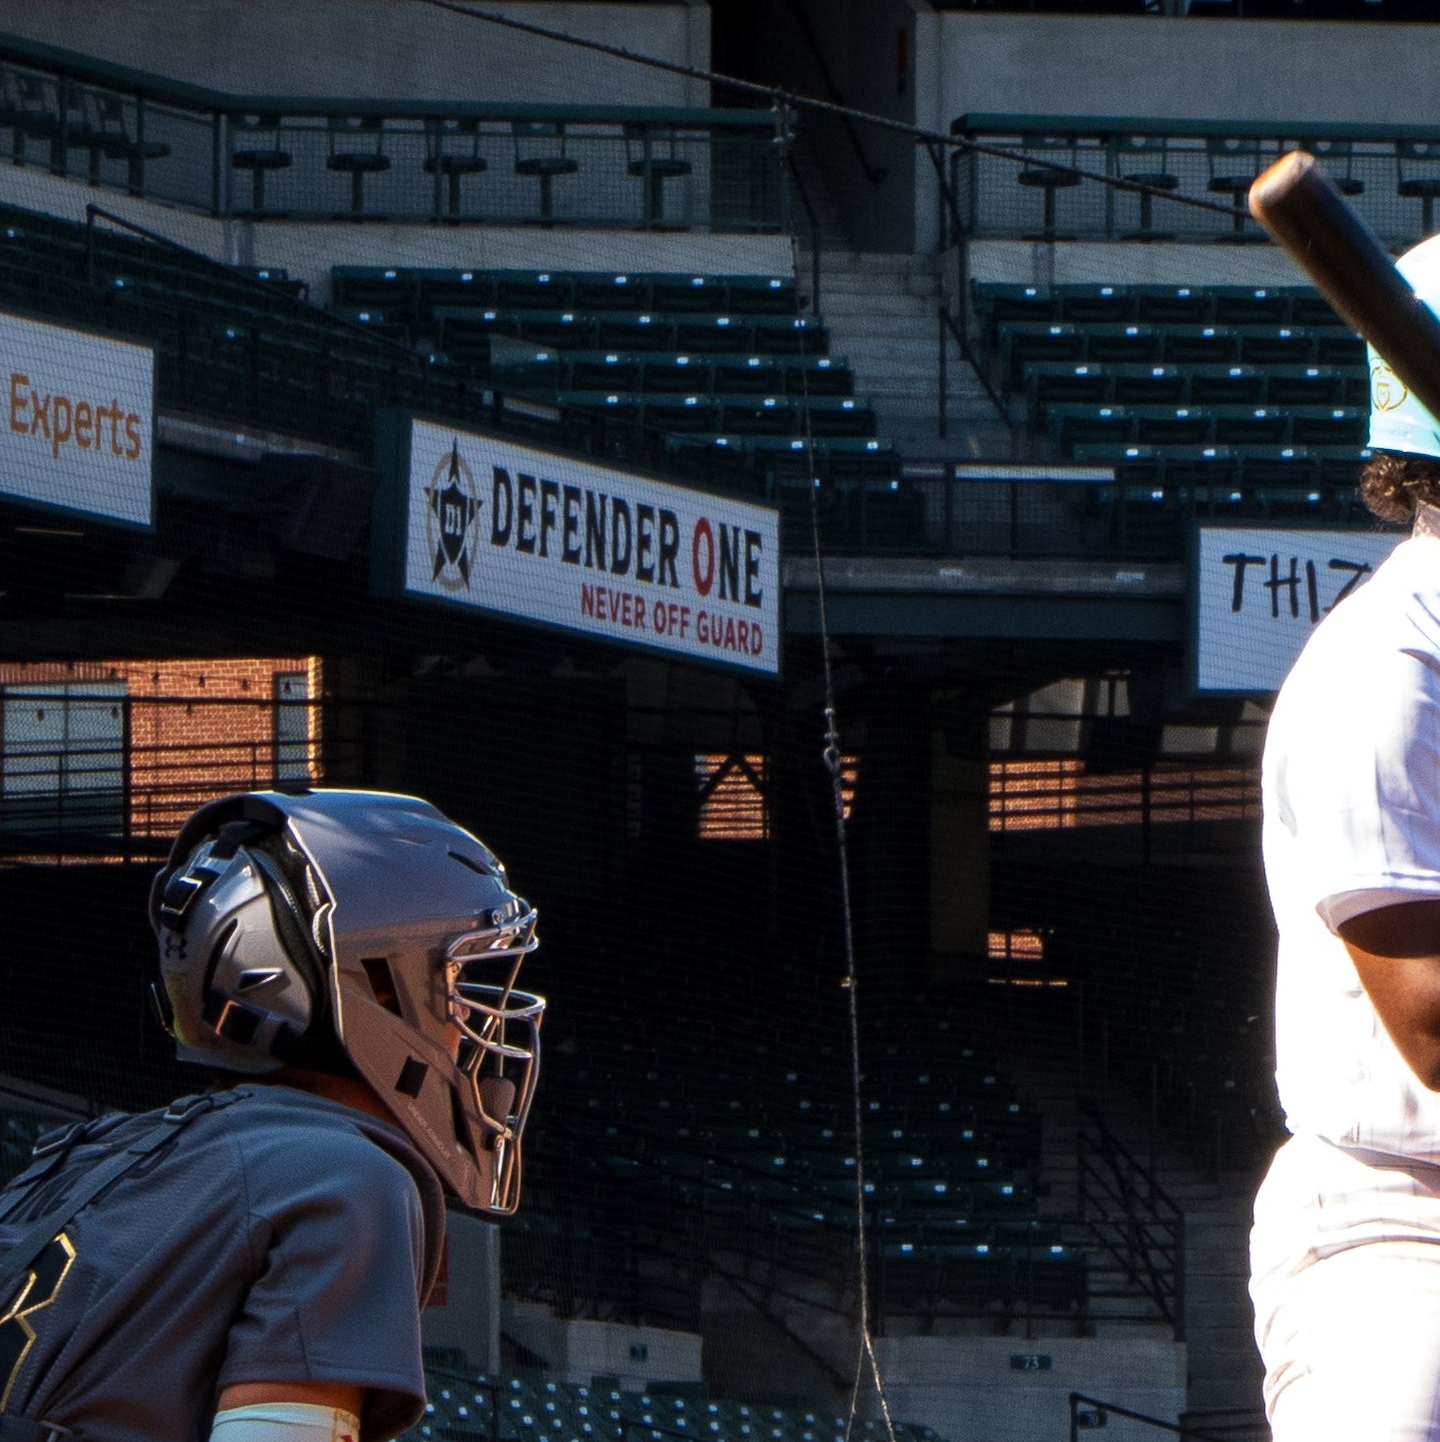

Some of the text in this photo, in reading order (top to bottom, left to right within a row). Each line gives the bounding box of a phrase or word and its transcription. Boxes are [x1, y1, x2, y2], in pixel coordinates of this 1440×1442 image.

[10, 372, 141, 460] Experts
[491, 465, 763, 608] DEFENDER ONE
[581, 583, 763, 656] NEVER OFF GUARD
